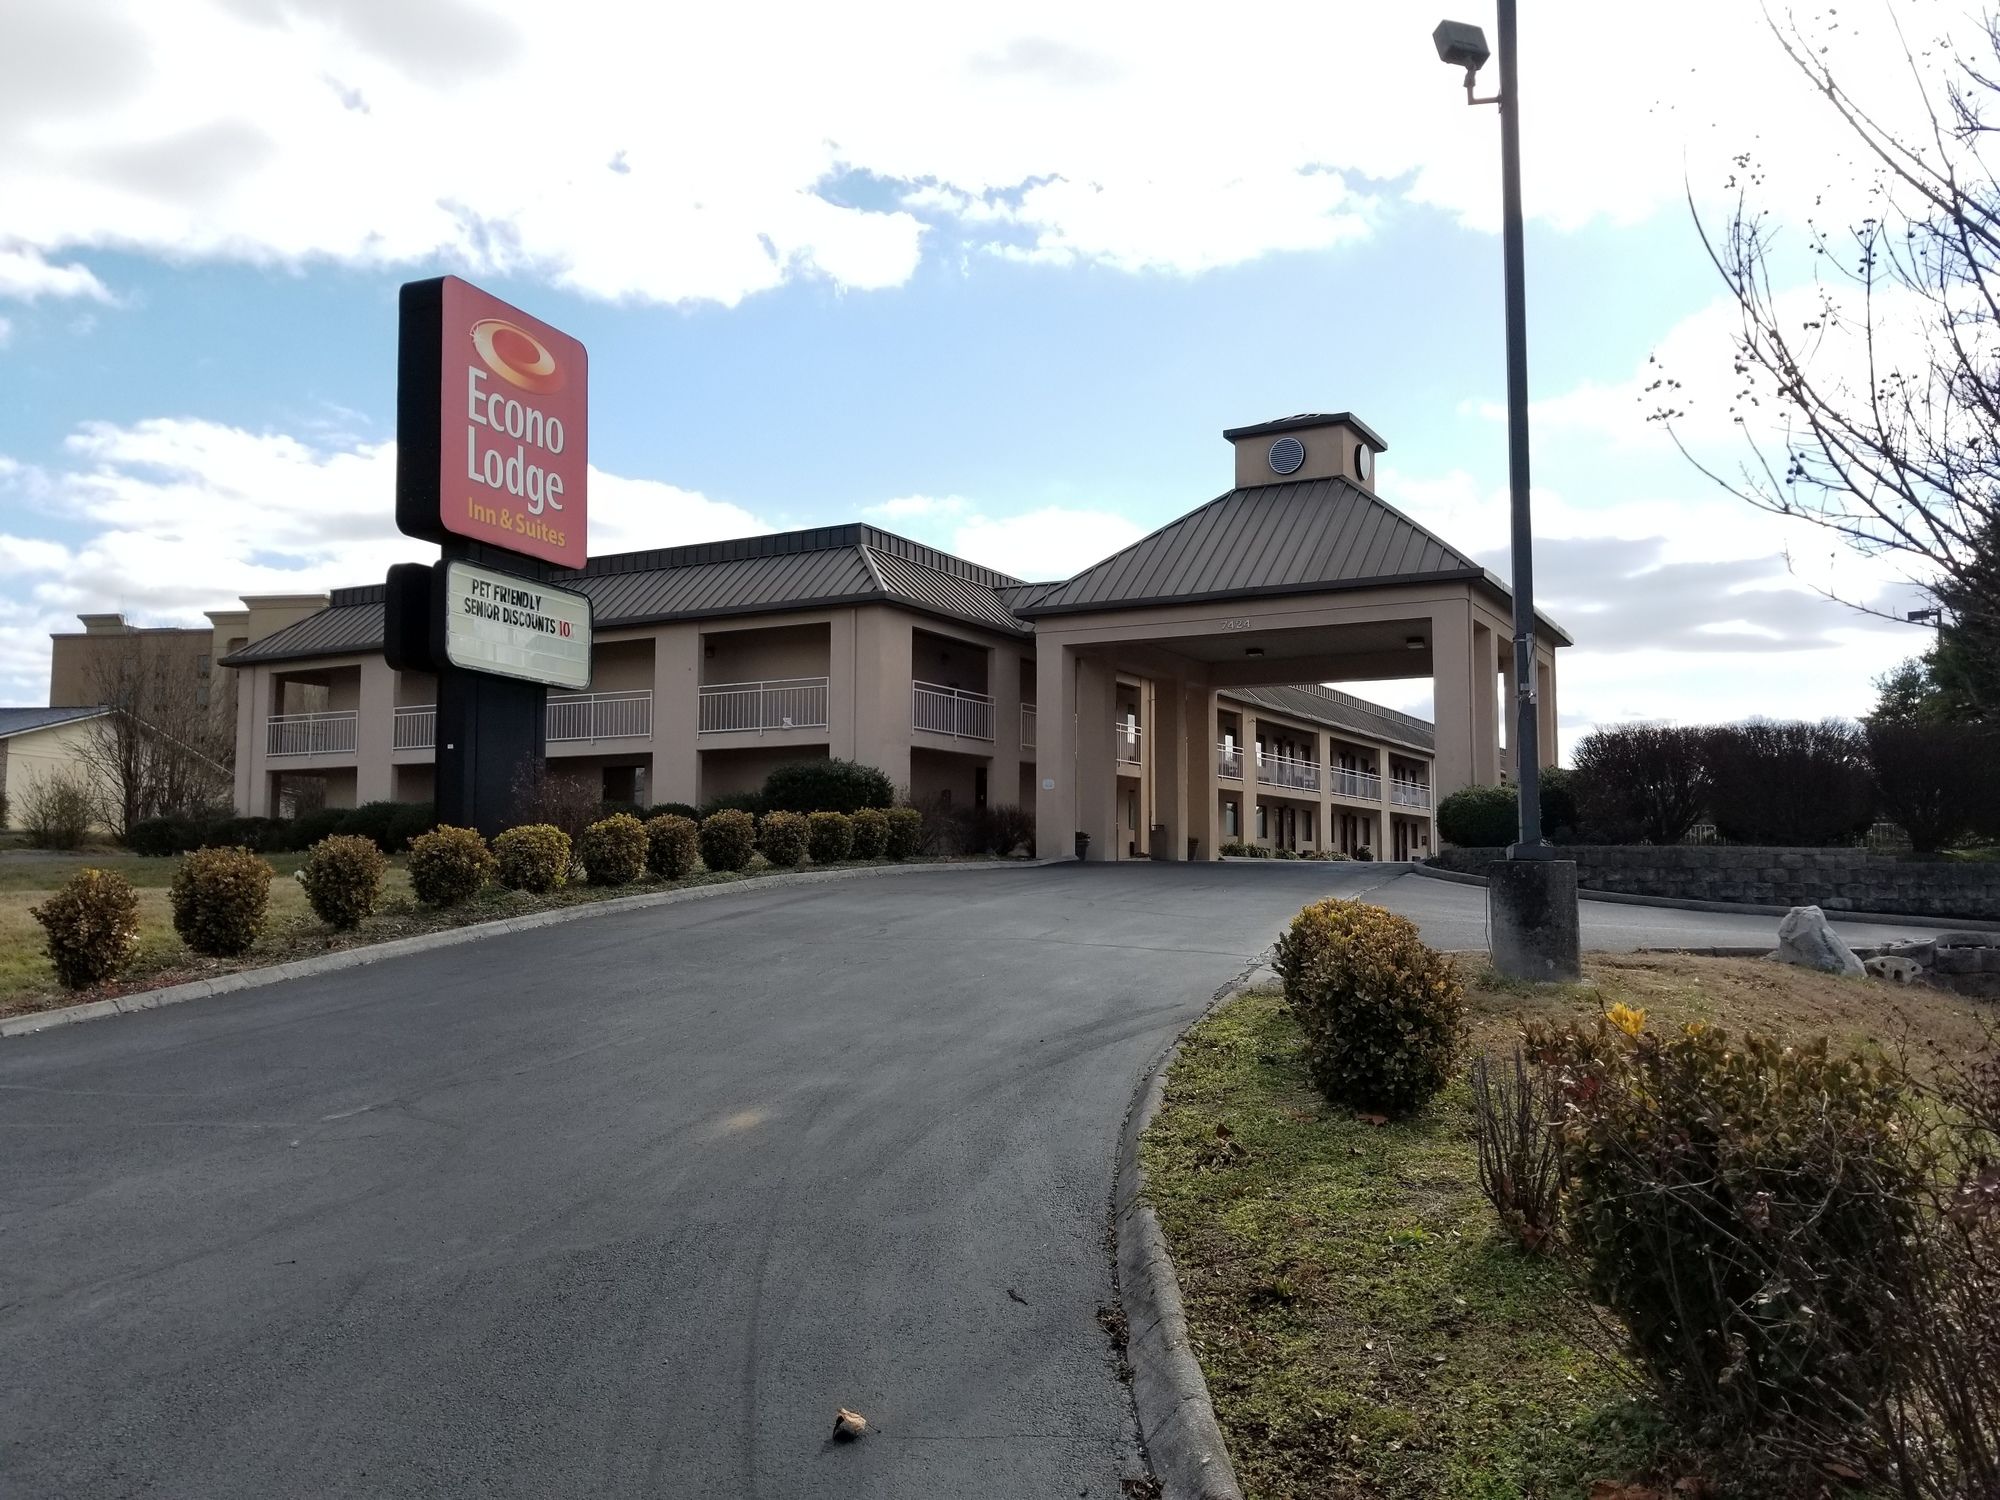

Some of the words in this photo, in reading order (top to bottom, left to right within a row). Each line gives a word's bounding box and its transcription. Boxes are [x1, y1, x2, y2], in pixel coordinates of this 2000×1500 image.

[467, 365, 564, 454] Econo
[467, 424, 564, 515] Lodge
[468, 497, 497, 526] Inn
[499, 508, 513, 529] &
[515, 513, 566, 548] Suites
[464, 597, 500, 622] SENIOR
[502, 606, 556, 634] DISCOUNTS
[472, 578, 491, 599] PET
[493, 585, 542, 612] FRIENDLY
[1220, 619, 1251, 631] 7424
